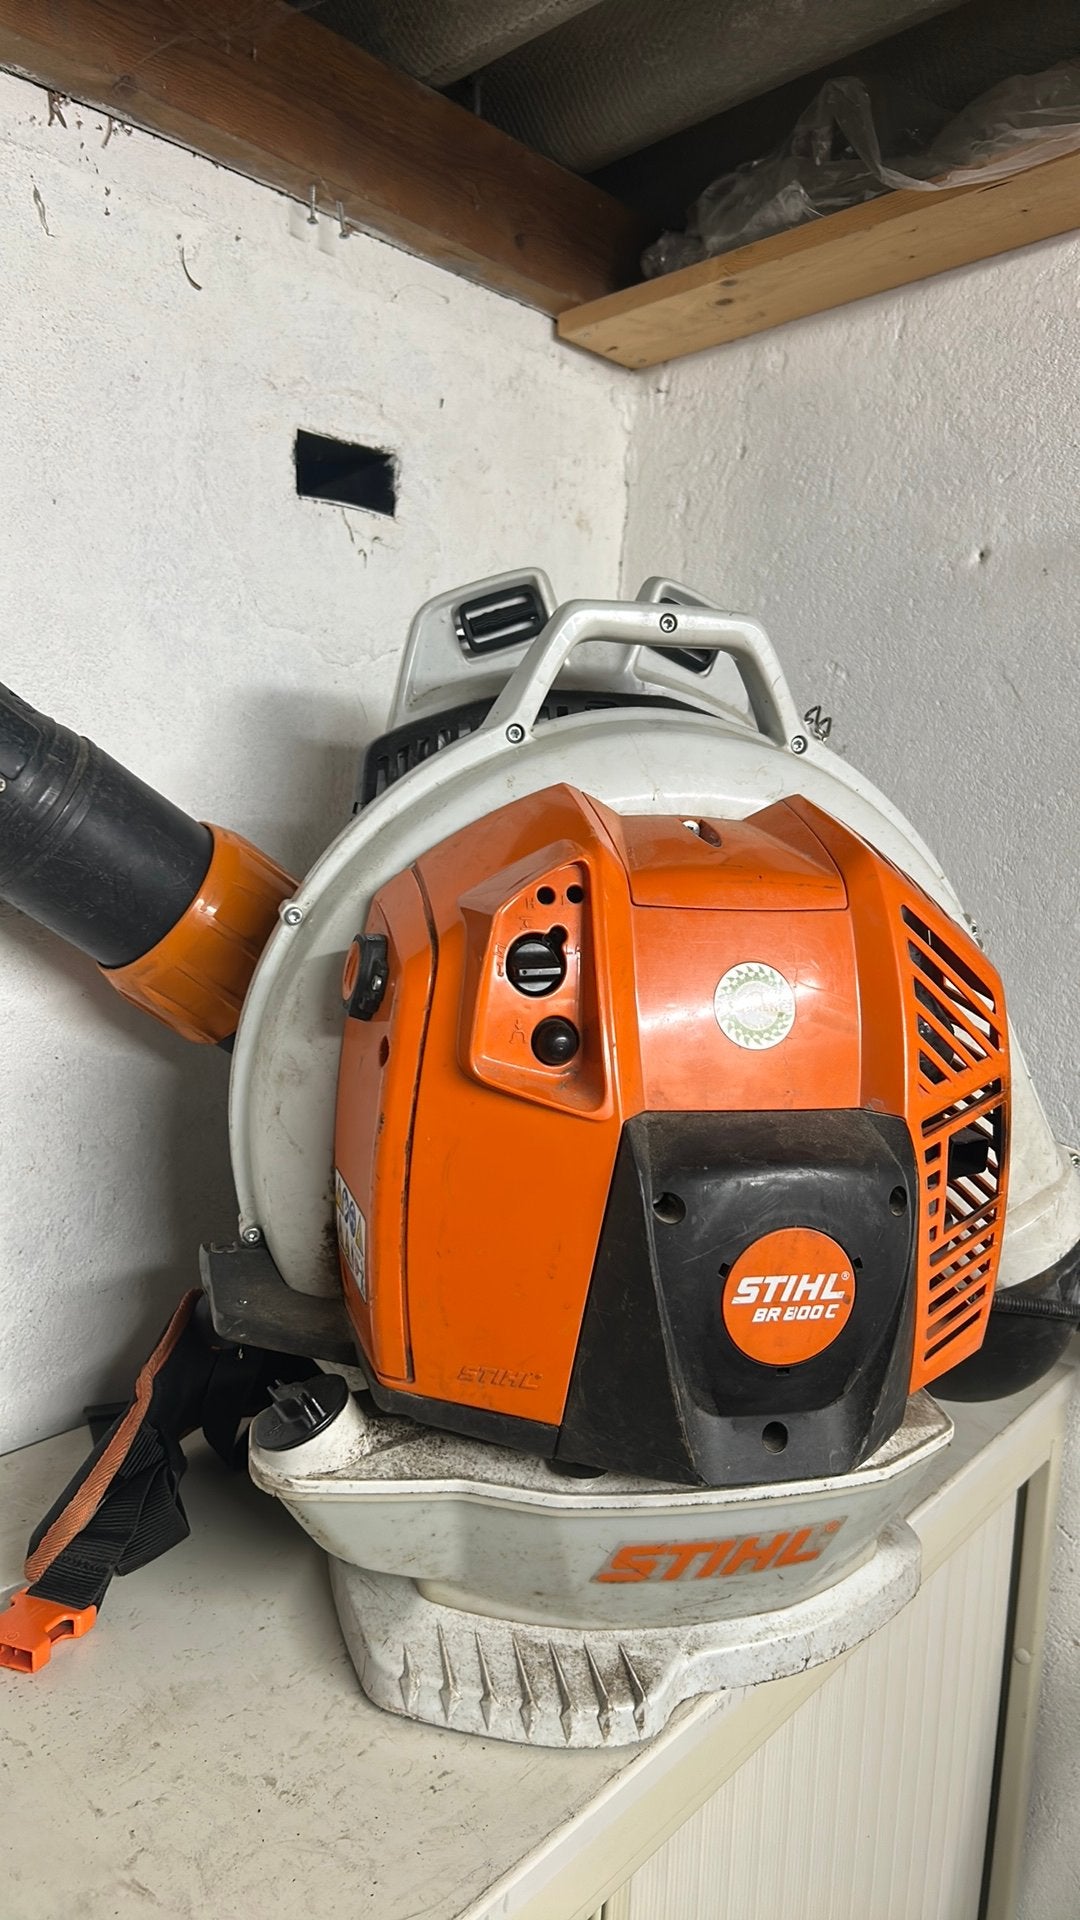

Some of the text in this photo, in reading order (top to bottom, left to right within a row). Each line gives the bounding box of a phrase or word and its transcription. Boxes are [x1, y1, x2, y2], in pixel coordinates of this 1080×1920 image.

[752, 1303, 840, 1322] BR 800 C
